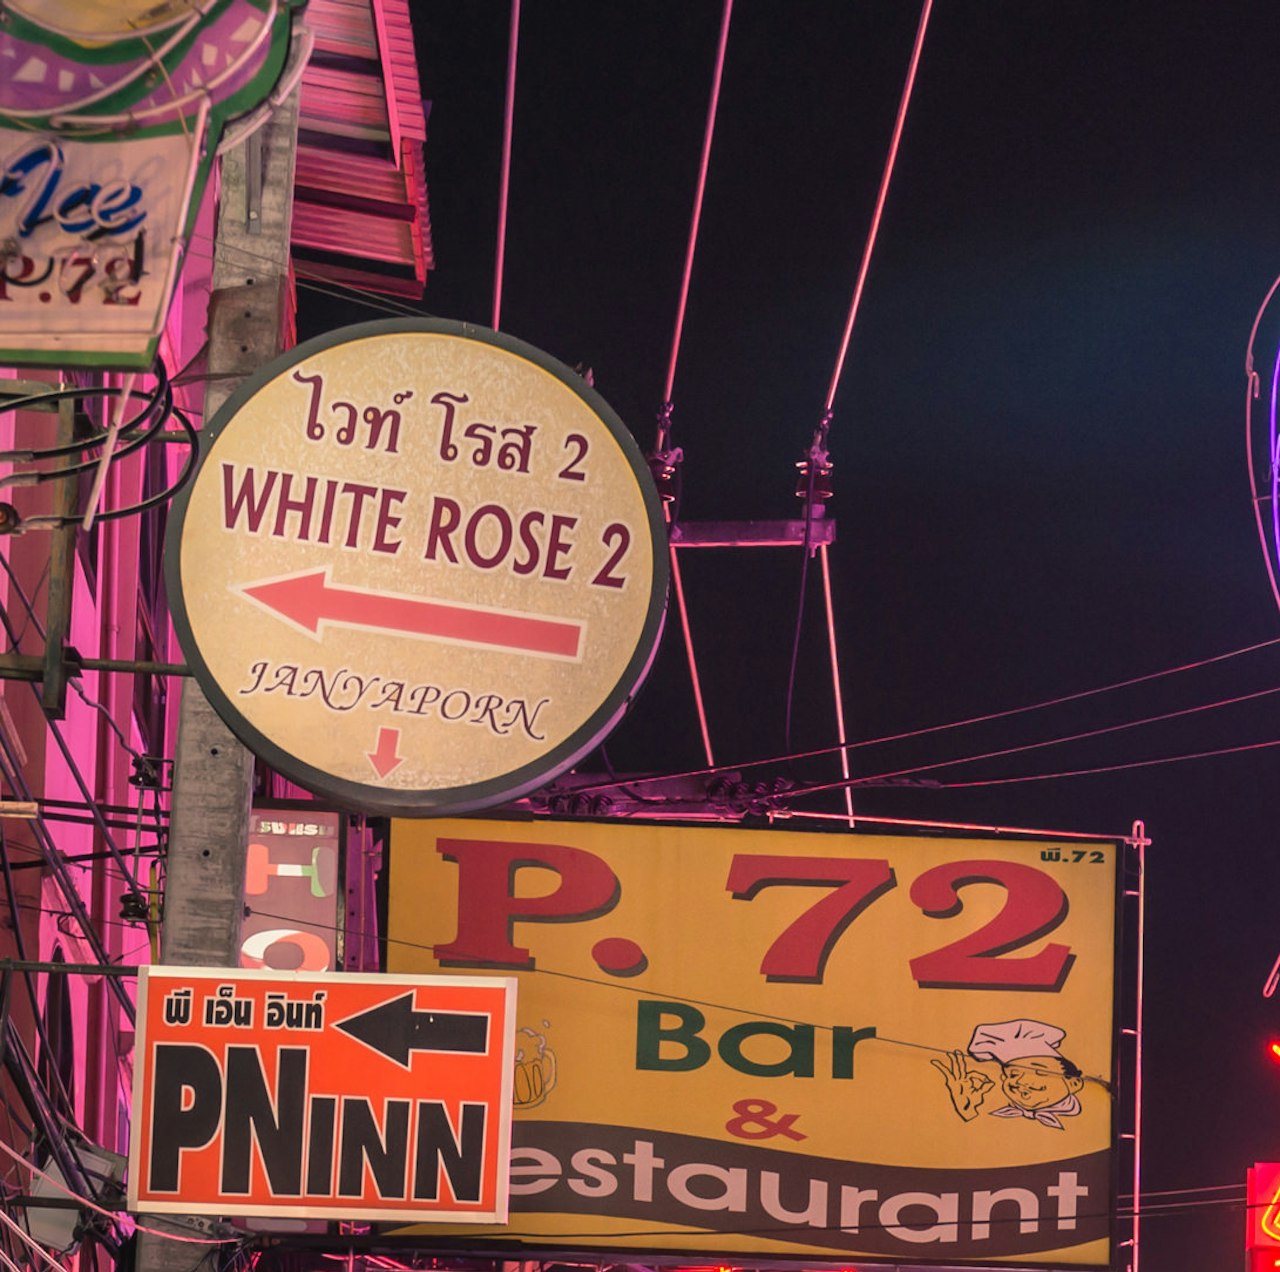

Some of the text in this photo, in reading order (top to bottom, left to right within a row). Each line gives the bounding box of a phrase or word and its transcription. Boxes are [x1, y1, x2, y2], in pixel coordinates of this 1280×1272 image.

[293, 371, 590, 482] ไวท์ โรส 2
[221, 463, 631, 589] WHITE ROSE 2
[239, 660, 549, 741] JANYAPORN
[433, 837, 648, 978] P.
[725, 853, 1077, 993] 72
[636, 1000, 877, 1080] Bar
[725, 1099, 808, 1141] &
[511, 1141, 1089, 1244] estaurant
